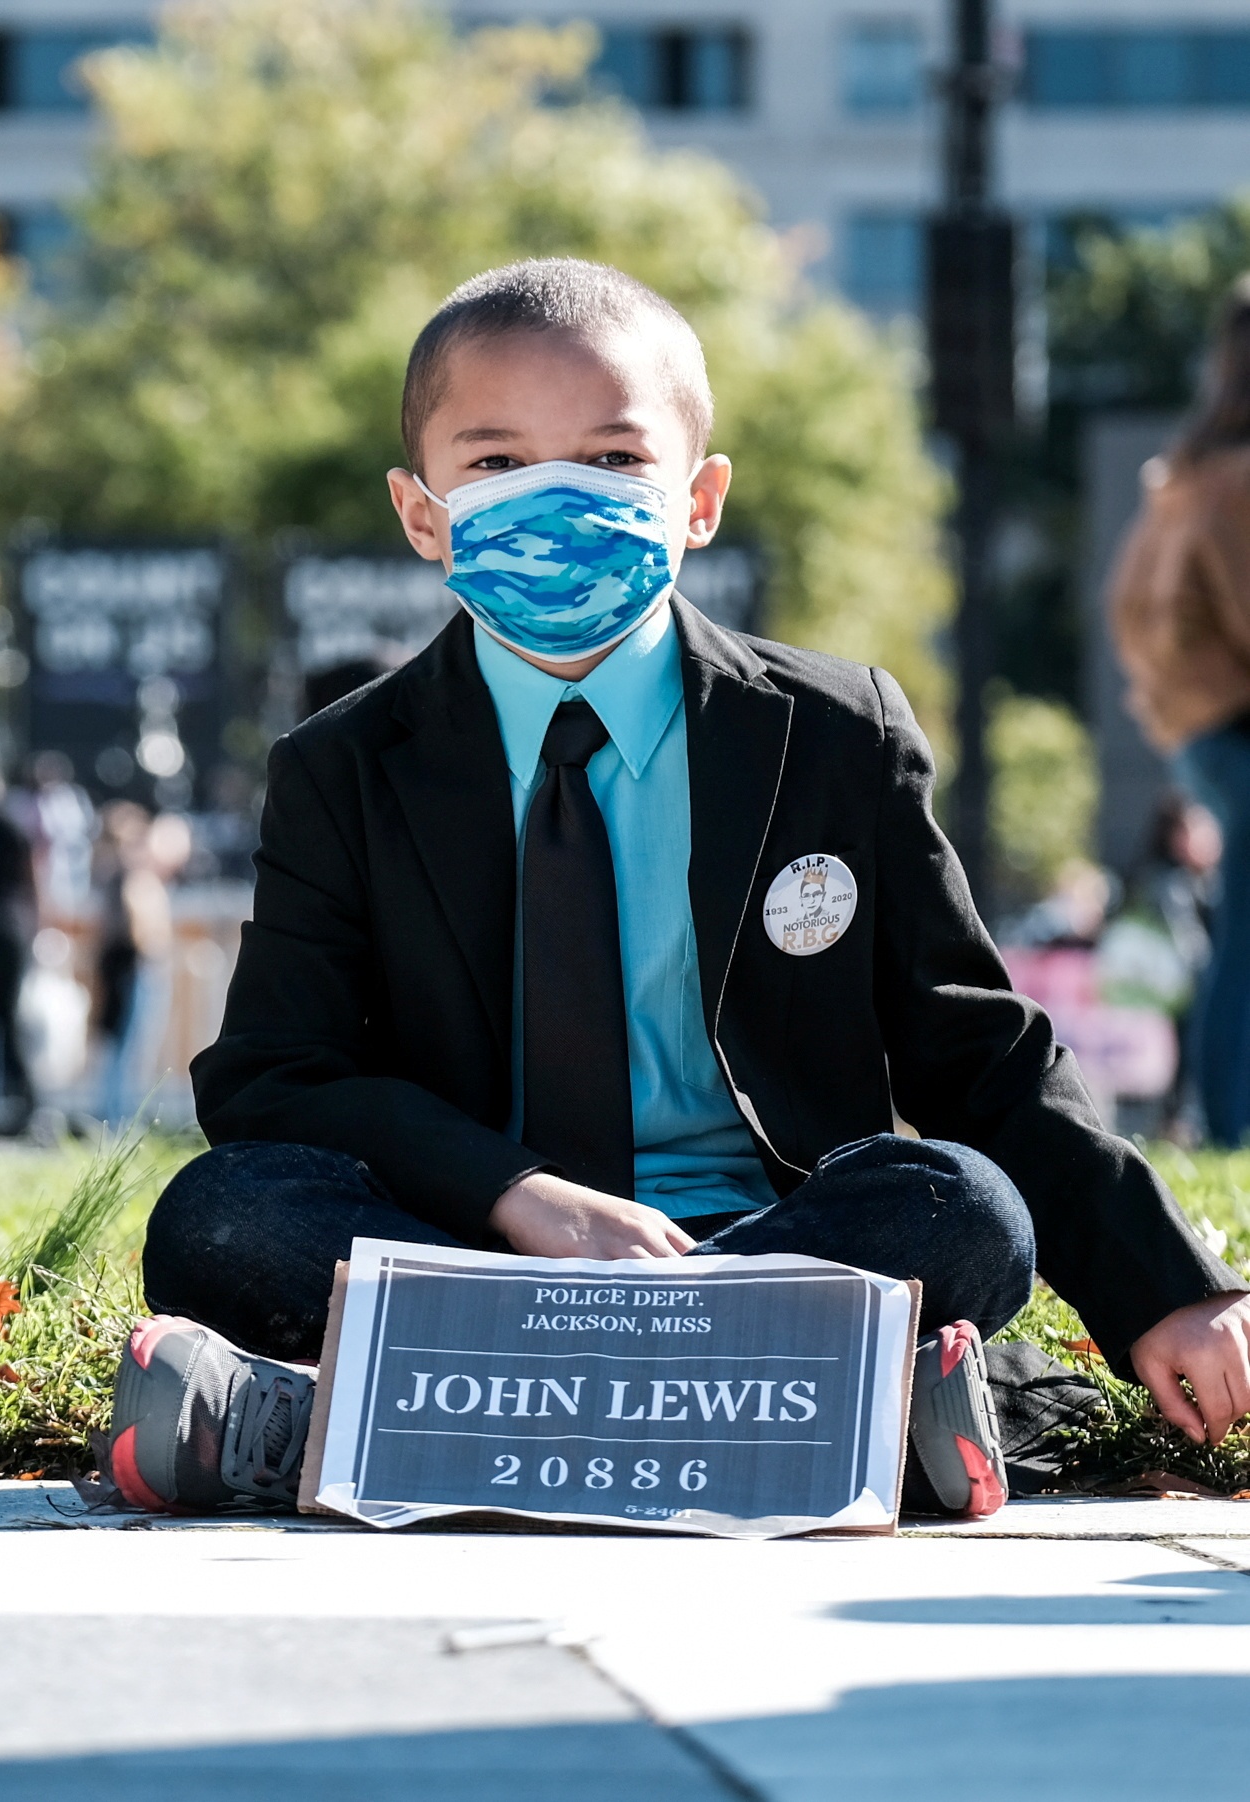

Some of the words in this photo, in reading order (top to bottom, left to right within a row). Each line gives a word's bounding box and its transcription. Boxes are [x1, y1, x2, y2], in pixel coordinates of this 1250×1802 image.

[790, 856, 829, 874] R.I.P.
[831, 892, 853, 903] 2020
[783, 913, 840, 933] NOTORIOUS
[535, 1287, 626, 1306] POLICE
[632, 1290, 705, 1308] DEPT.
[521, 1313, 643, 1336] JACKSON,
[650, 1316, 712, 1334] MISS
[396, 1372, 586, 1417] JOHN
[605, 1378, 819, 1423] LEWIS
